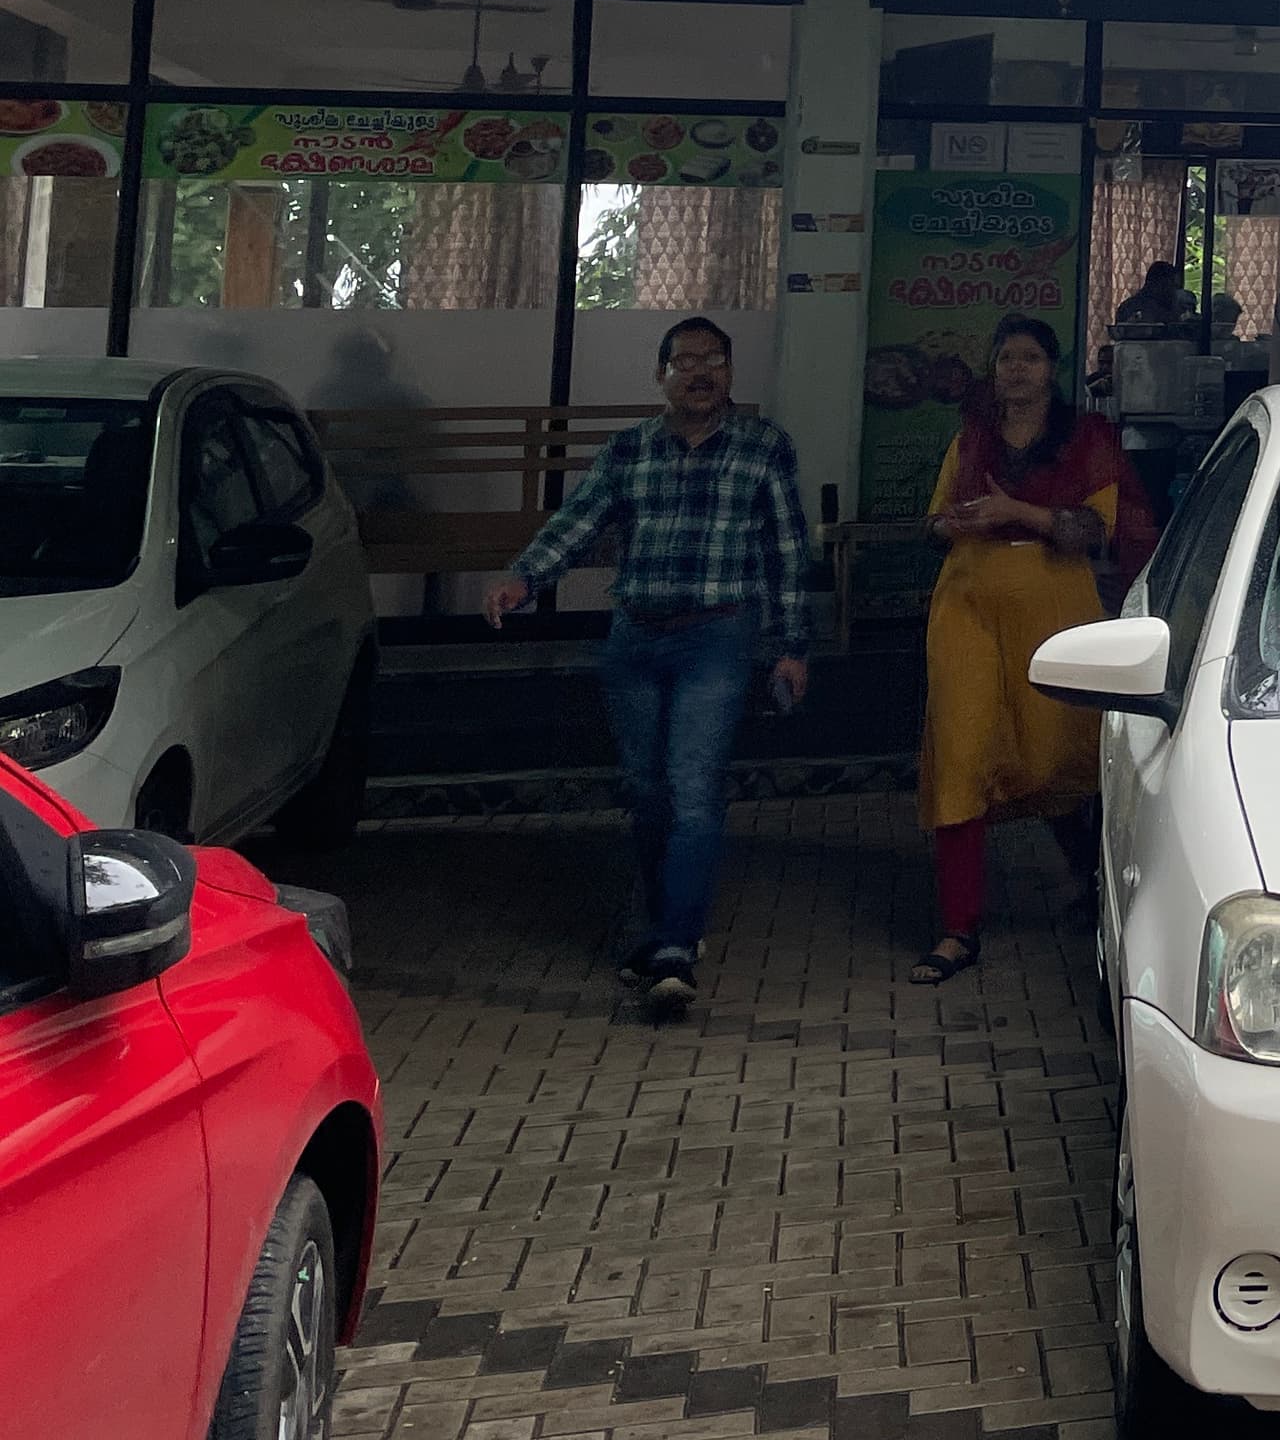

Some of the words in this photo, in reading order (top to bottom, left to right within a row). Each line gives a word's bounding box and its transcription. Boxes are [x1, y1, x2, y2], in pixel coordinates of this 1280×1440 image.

[293, 132, 394, 151] നാടൻ
[931, 181, 1035, 209] സുശീല
[909, 209, 1054, 238] ചേച്ചിയുടെ
[921, 246, 1023, 273] നാടൻ
[888, 275, 1064, 309] ഭക്ഷണശാല
